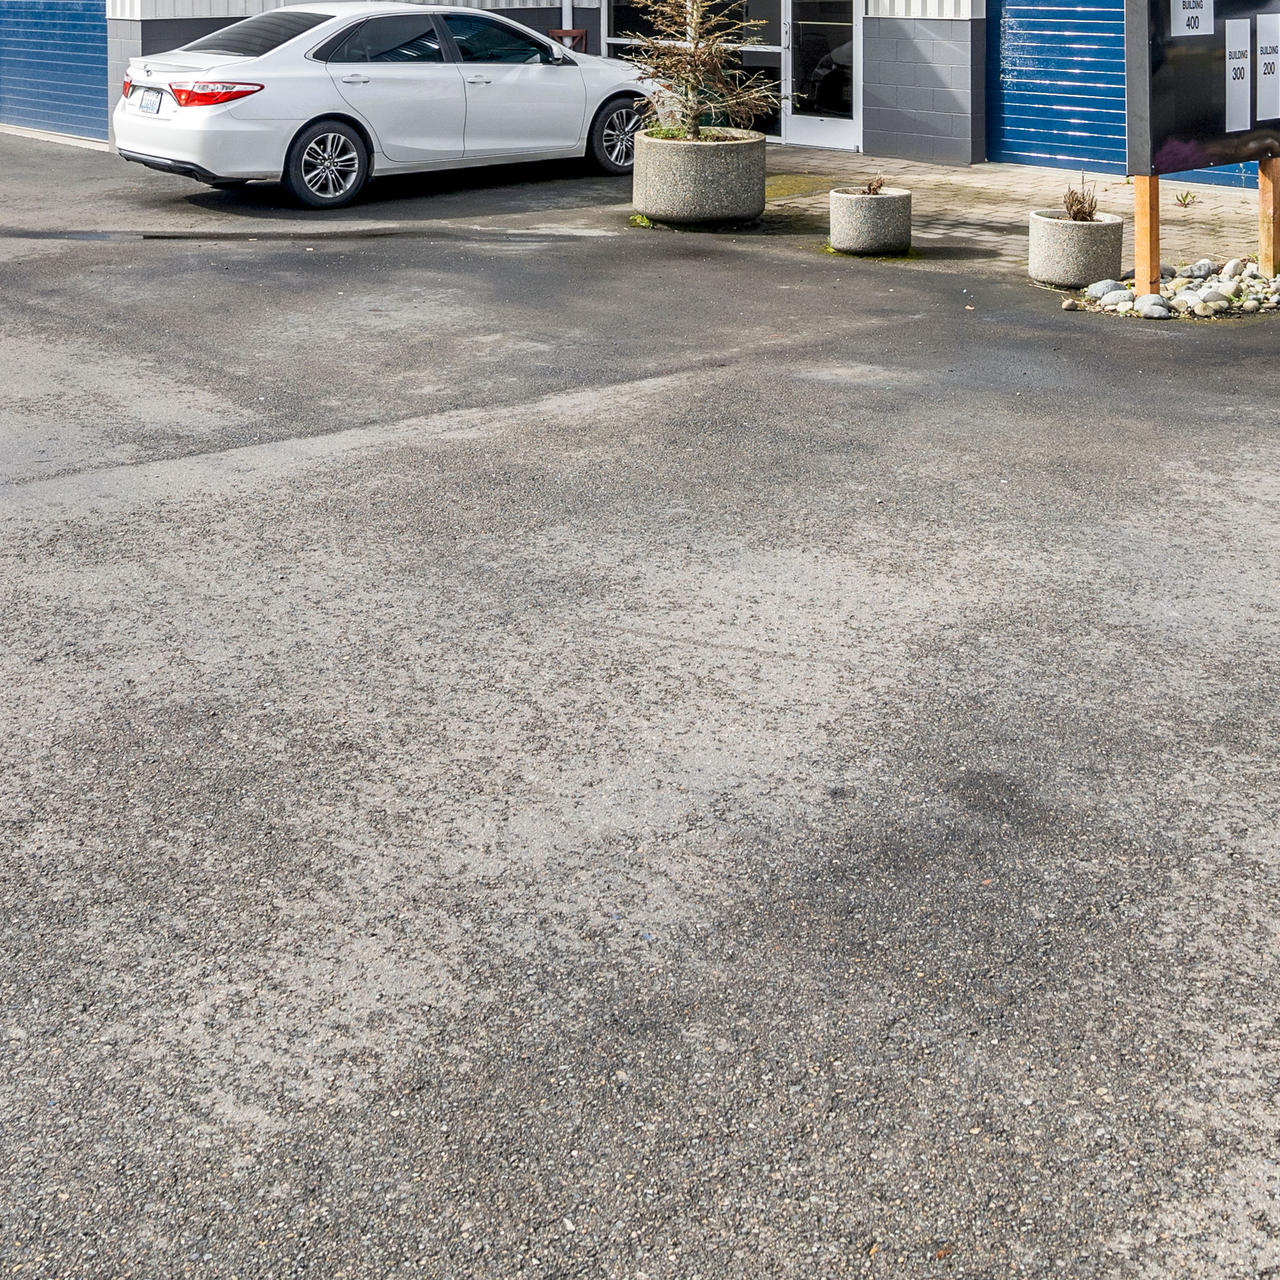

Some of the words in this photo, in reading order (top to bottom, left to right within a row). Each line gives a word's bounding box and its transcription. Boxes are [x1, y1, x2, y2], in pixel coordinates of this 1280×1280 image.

[1182, 0, 1203, 10] BUILDING
[1186, 16, 1199, 30] 400
[1228, 50, 1248, 60] BUILDING
[1260, 45, 1279, 55] BUILDING
[1232, 66, 1245, 80] 300
[1263, 62, 1275, 75] 200
